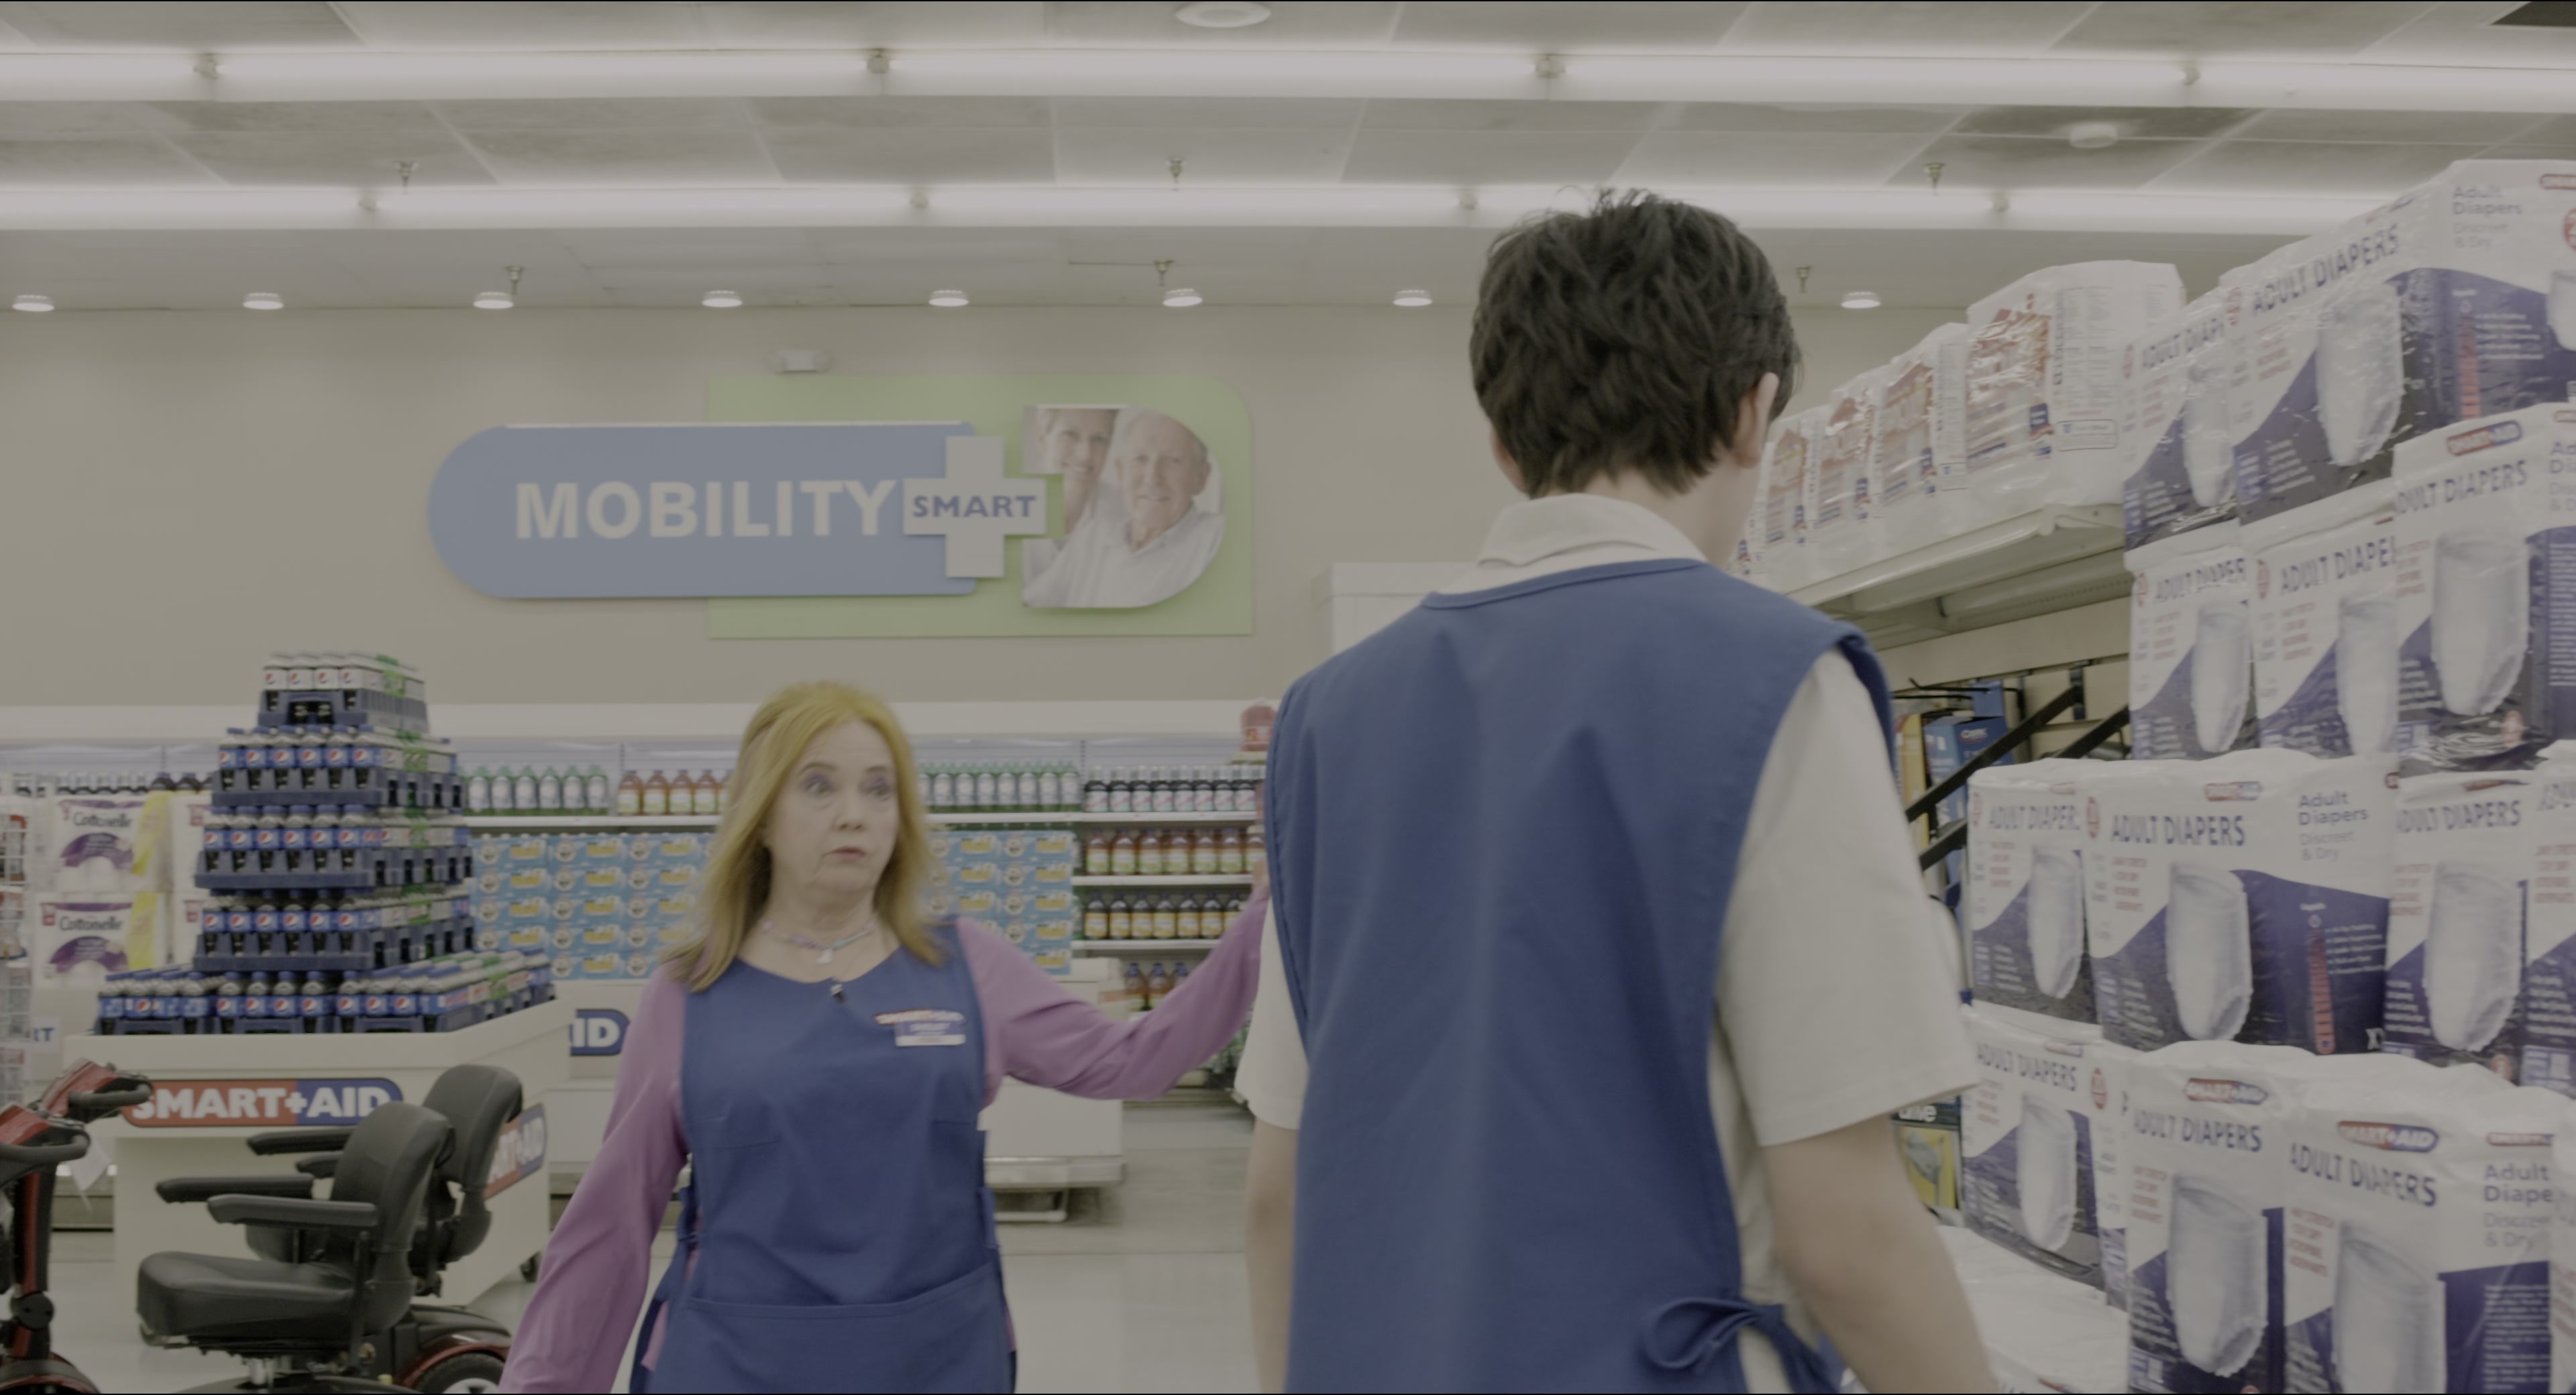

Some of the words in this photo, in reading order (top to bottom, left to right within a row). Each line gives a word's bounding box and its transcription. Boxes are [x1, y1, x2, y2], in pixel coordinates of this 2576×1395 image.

[2453, 201, 2523, 218] Diapers
[2252, 266, 2308, 317] ADULT
[2314, 224, 2400, 288] DIAPERS
[2444, 459, 2528, 503] DIAPERS
[516, 480, 896, 539] MOBILITY
[911, 494, 1037, 518] SMART
[2279, 554, 2328, 596] ADULT
[2334, 535, 2396, 580] DIAPE
[2298, 789, 2351, 808] Adult
[2442, 799, 2522, 831] DIAPERS
[2111, 814, 2158, 844] ADULT
[2163, 814, 2247, 846] DIAPERS
[2298, 808, 2369, 826] Diapers
[570, 1017, 621, 1048] ID
[2018, 1052, 2078, 1093] DIAPERS
[132, 1086, 391, 1119] SMART+AID
[2182, 1116, 2263, 1154] DIAPERS
[2349, 1157, 2438, 1208] DIAPERS
[2484, 1162, 2552, 1182] Adult
